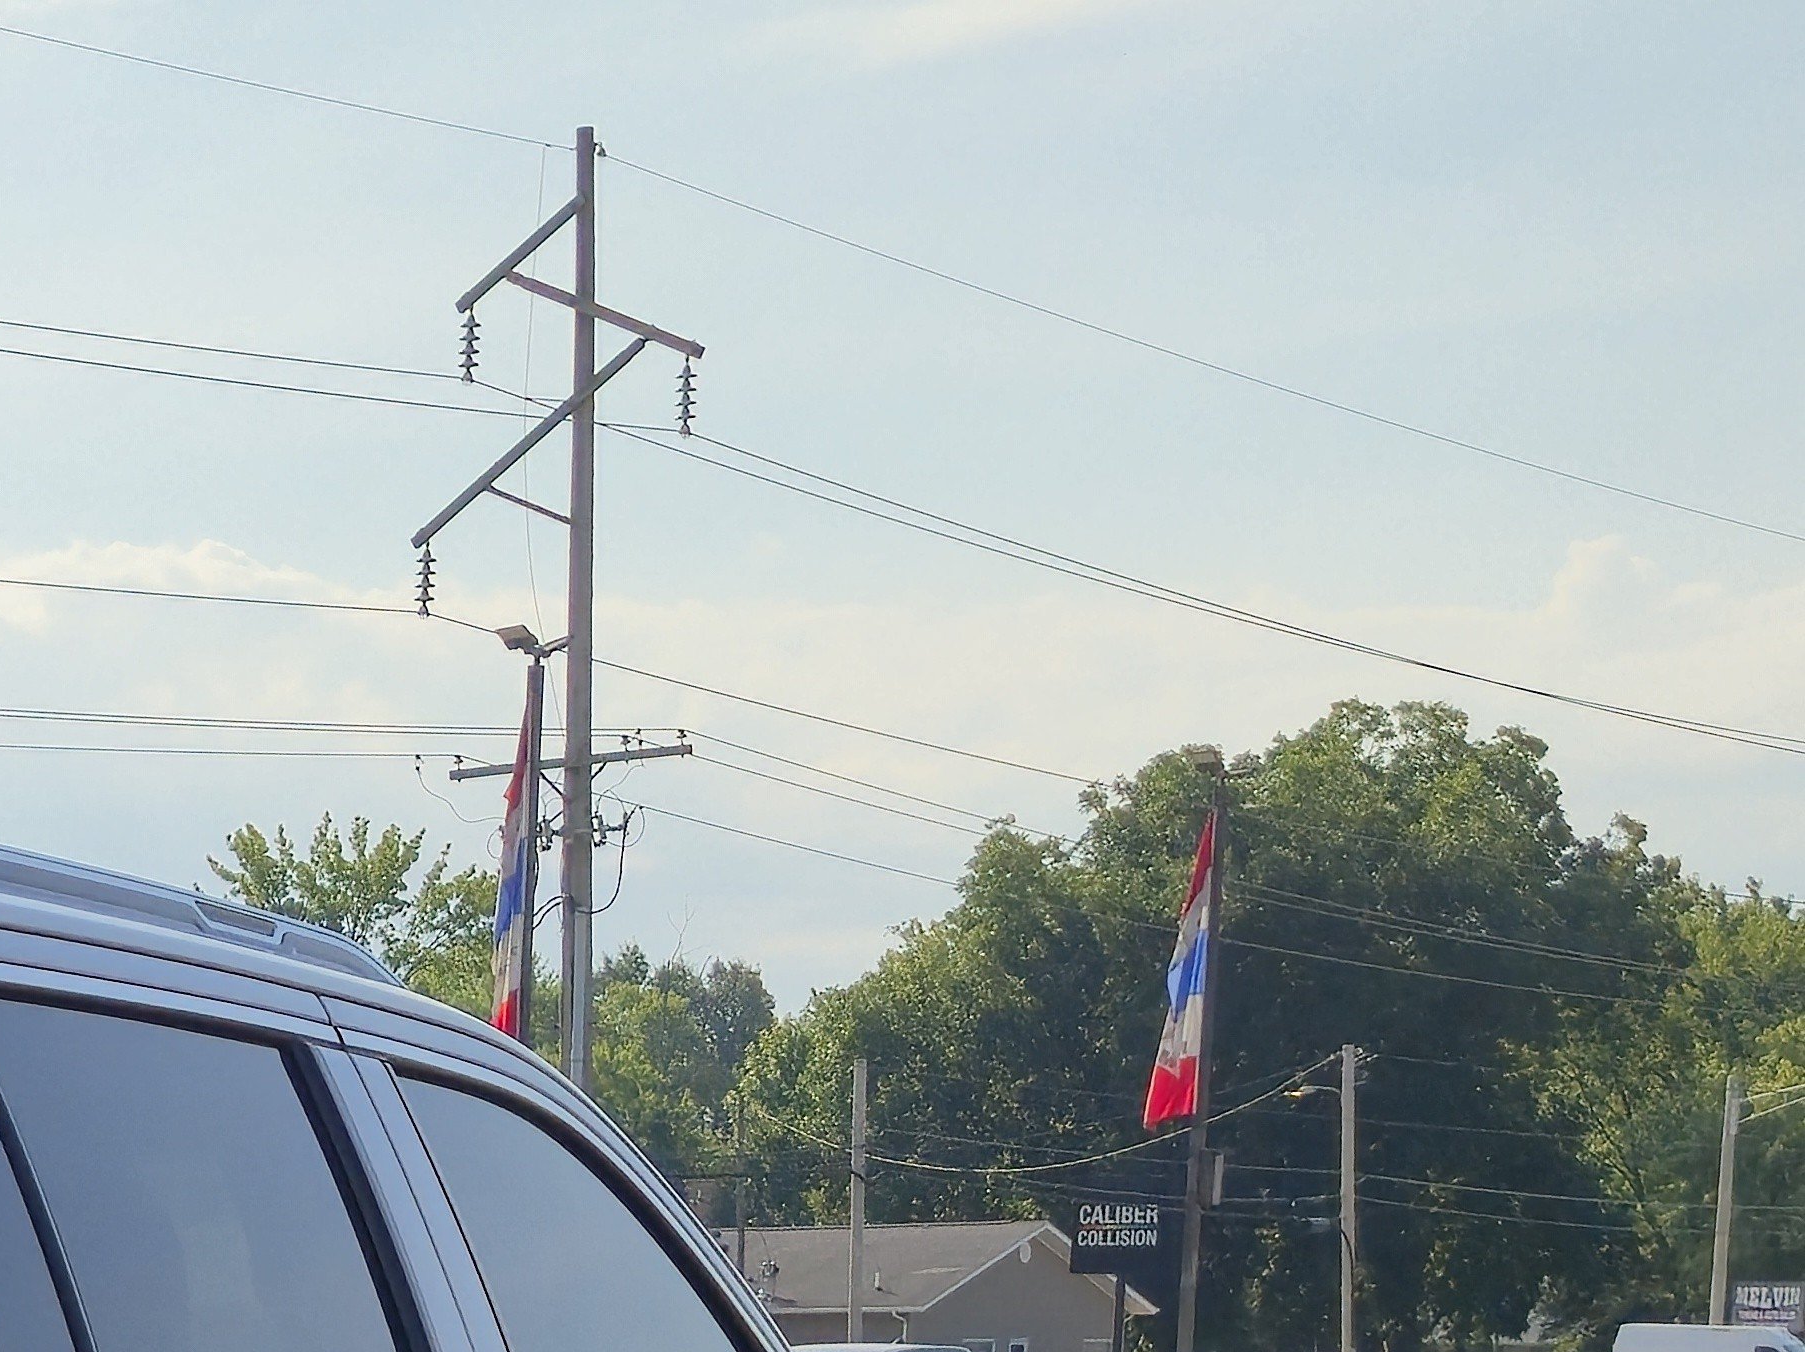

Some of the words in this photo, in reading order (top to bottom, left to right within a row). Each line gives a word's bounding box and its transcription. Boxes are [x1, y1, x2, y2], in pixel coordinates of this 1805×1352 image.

[1078, 1203, 1159, 1225] CALIBER
[1077, 1229, 1158, 1247] COLLISION
[1735, 1286, 1801, 1309] MELVIN
